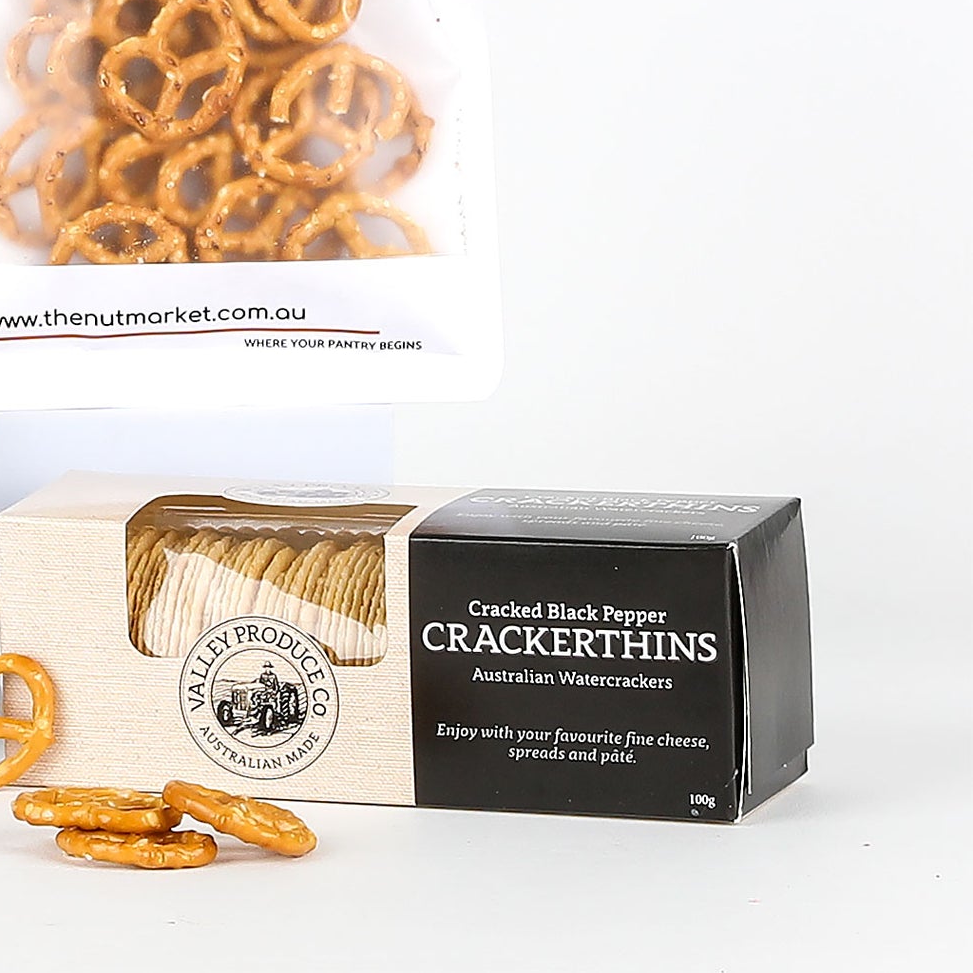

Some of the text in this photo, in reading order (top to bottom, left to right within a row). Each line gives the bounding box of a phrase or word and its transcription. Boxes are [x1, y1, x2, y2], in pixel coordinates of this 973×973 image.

[244, 339, 422, 350] WHERE YOUR PANTRY BEGINS
[468, 600, 667, 627] Cracked Black Pepper
[422, 622, 718, 662] CRACKERTHINS
[188, 631, 232, 712] VALLEY
[233, 624, 325, 684] PRODUCE
[472, 667, 673, 689] Australian Watercrackers
[199, 726, 320, 769] AUSTRALIAN MADE
[436, 723, 710, 750] Enjoy with your favourite fine cheese,
[508, 746, 637, 765] spreads and pâté.
[690, 794, 716, 809] 100g
